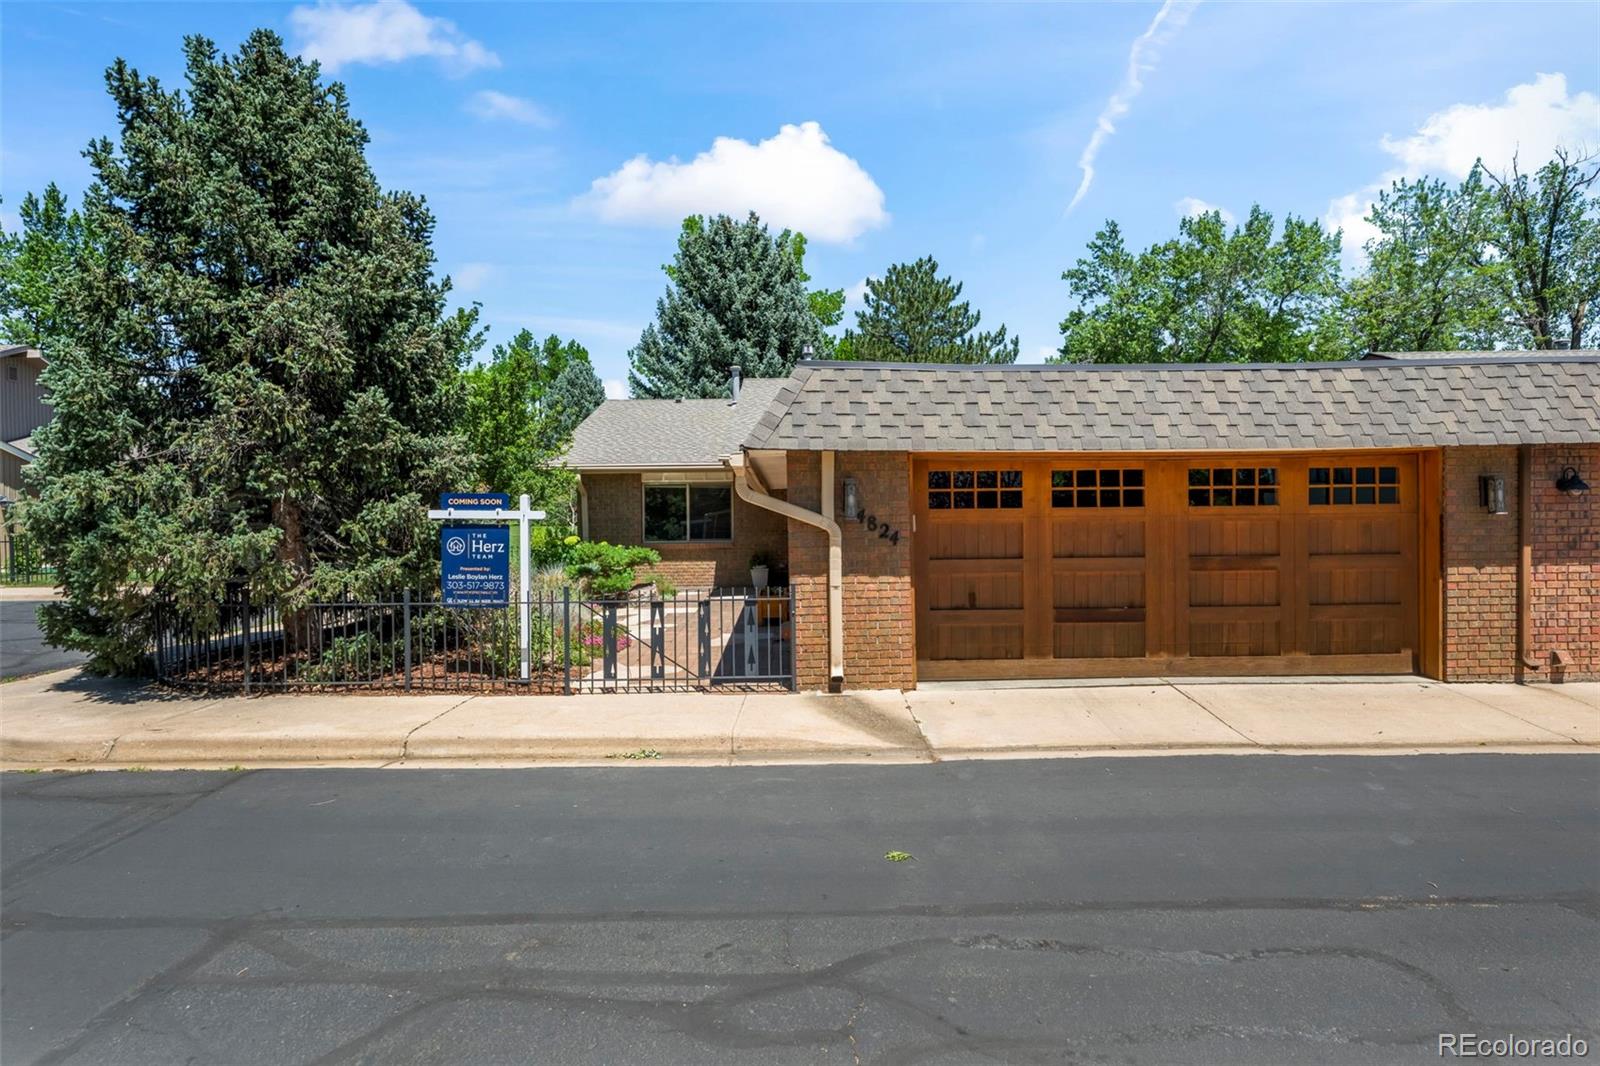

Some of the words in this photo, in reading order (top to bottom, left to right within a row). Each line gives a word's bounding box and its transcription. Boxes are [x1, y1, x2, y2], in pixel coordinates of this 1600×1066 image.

[857, 508, 900, 546] 4824
[472, 539, 504, 553] Herz
[447, 581, 504, 589] 303-517-9873
